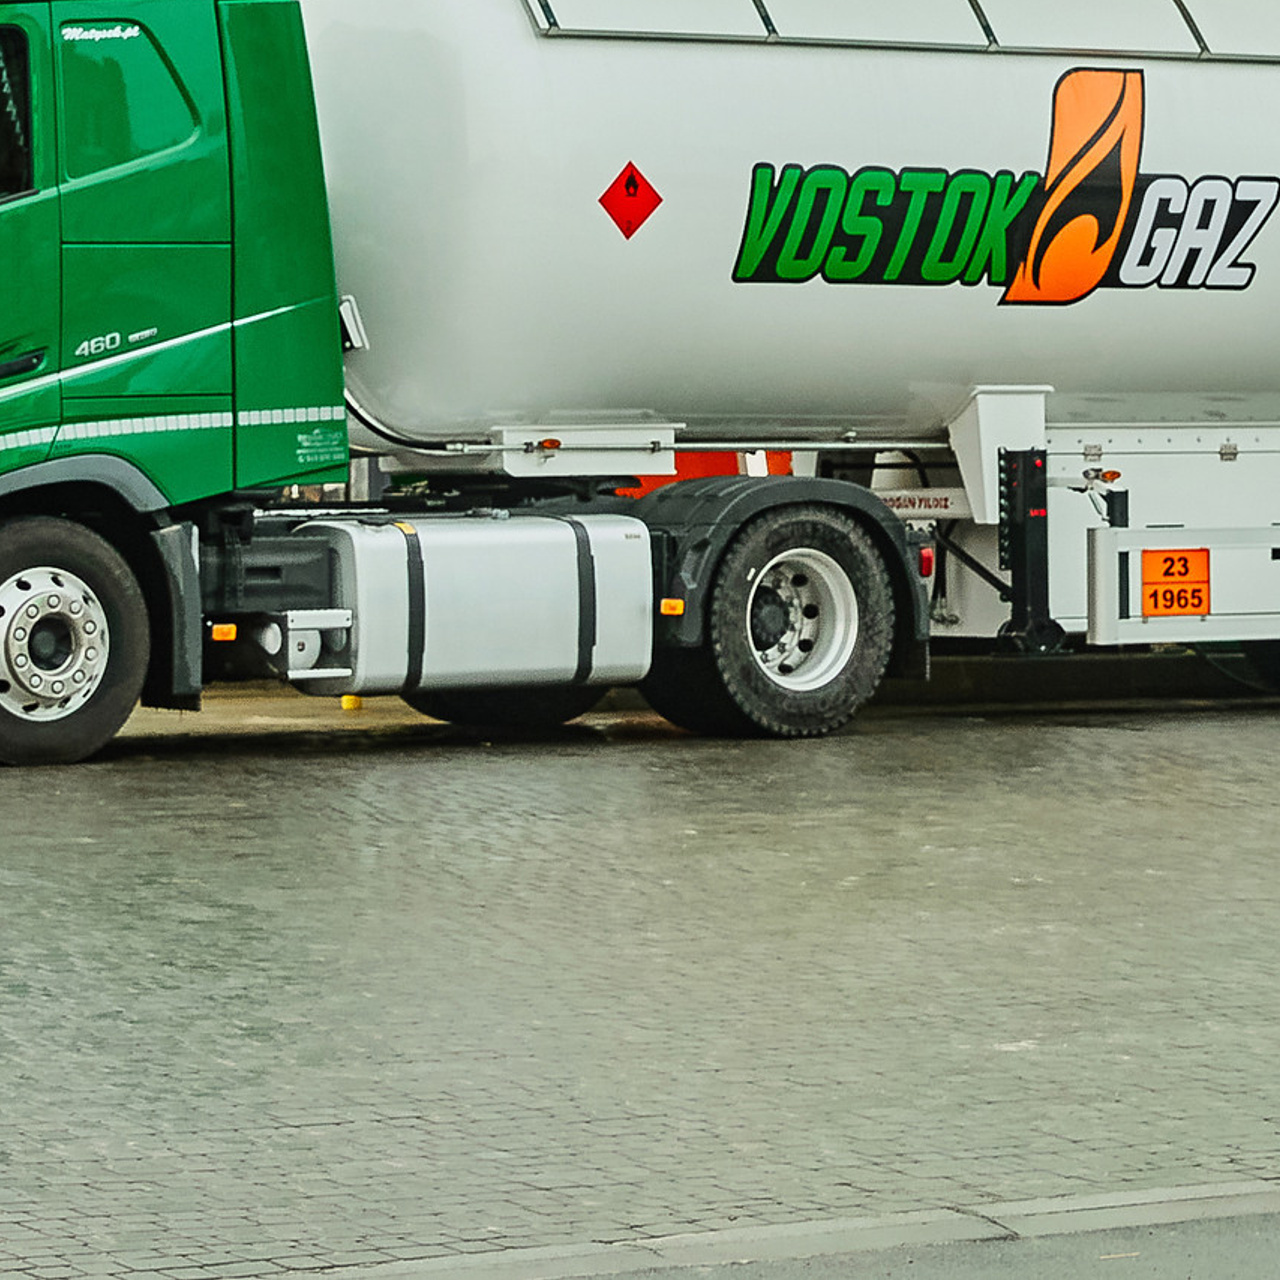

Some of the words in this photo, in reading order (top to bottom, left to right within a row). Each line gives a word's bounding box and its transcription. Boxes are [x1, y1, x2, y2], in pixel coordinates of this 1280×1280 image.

[734, 163, 1038, 283] VOSTOK
[1120, 178, 1280, 286] GAZ
[75, 332, 120, 356] 460
[1163, 557, 1190, 577] 23
[1149, 588, 1203, 609] 1965
